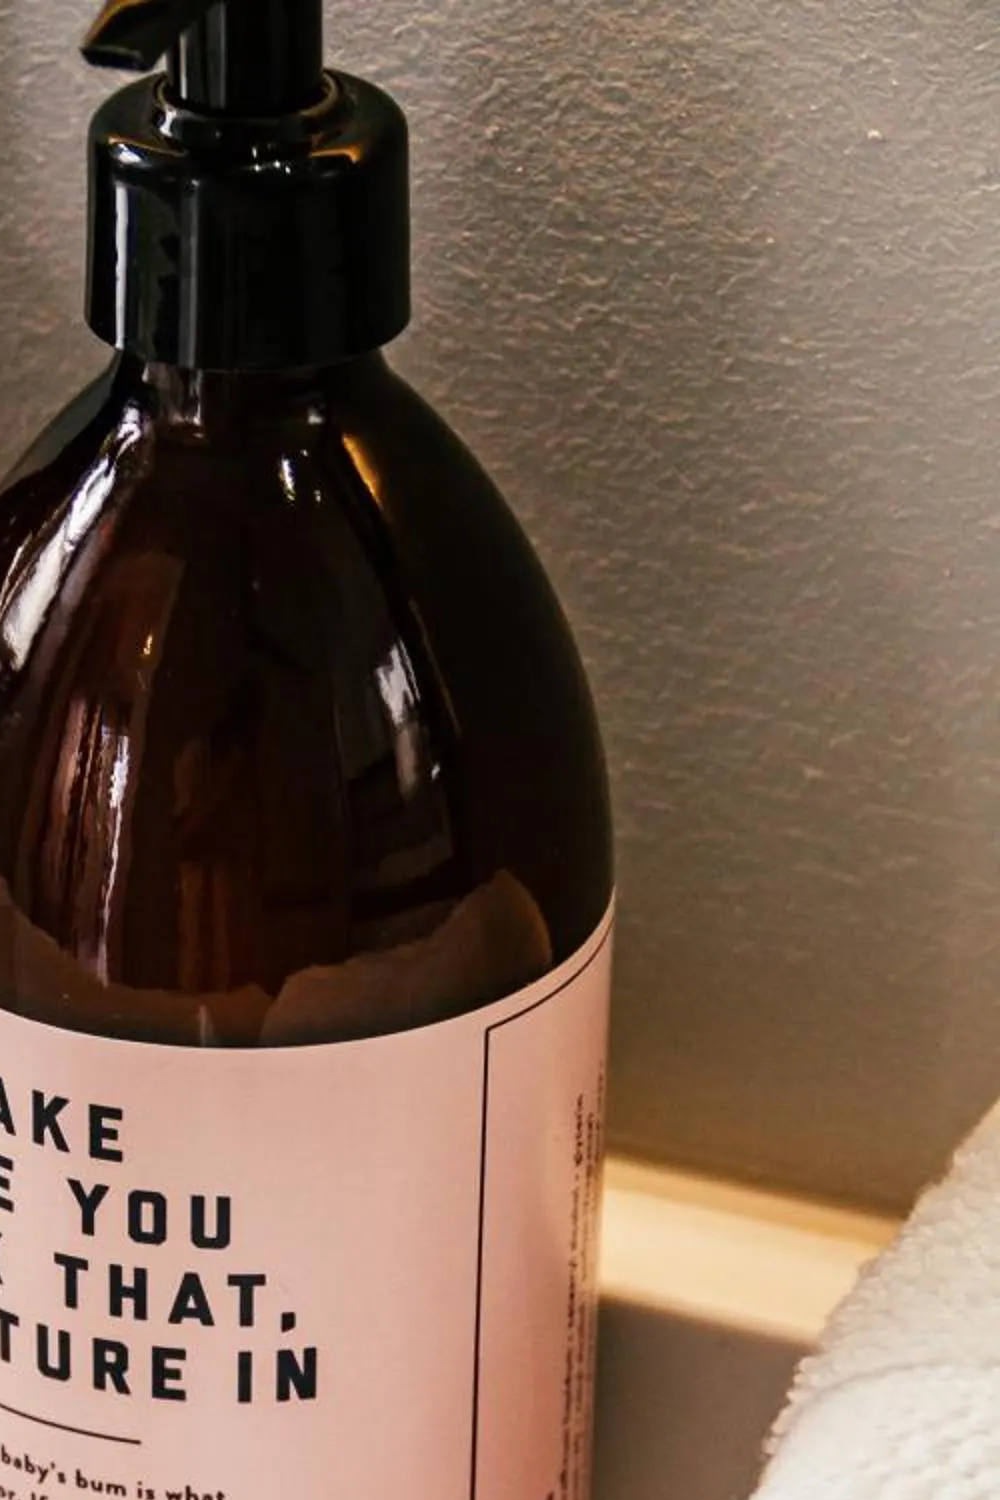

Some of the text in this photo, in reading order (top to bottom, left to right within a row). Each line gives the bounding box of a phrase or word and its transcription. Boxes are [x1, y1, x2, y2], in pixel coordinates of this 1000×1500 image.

[67, 1178, 231, 1249] YOU
[53, 1252, 296, 1332] THAT,
[237, 1347, 317, 1403] IN
[0, 1443, 66, 1484] baby's
[75, 1469, 127, 1498] bum
[136, 1480, 155, 1500] is
